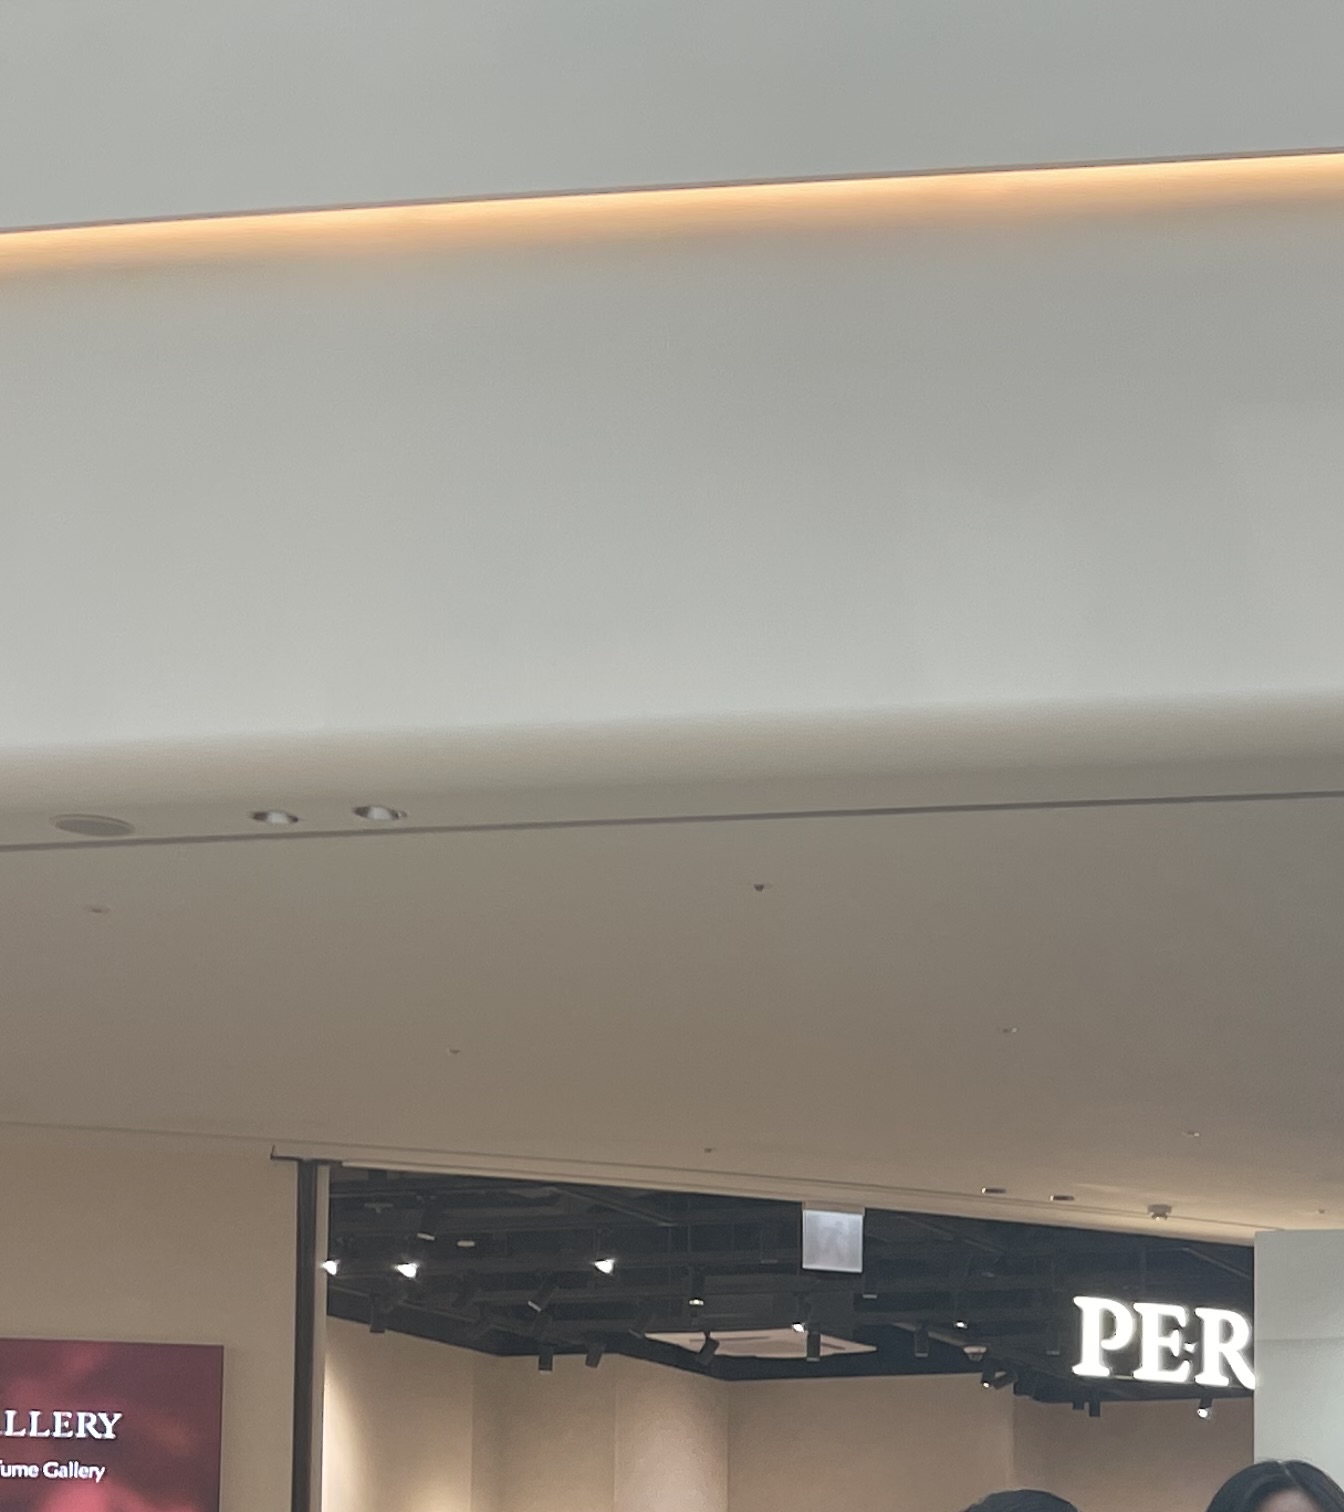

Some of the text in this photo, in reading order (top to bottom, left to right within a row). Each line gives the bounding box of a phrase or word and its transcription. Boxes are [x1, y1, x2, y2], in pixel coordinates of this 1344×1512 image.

[1072, 1296, 1255, 1390] PER
[0, 1410, 122, 1439] LLERY
[0, 1460, 105, 1483] ume Gallery
